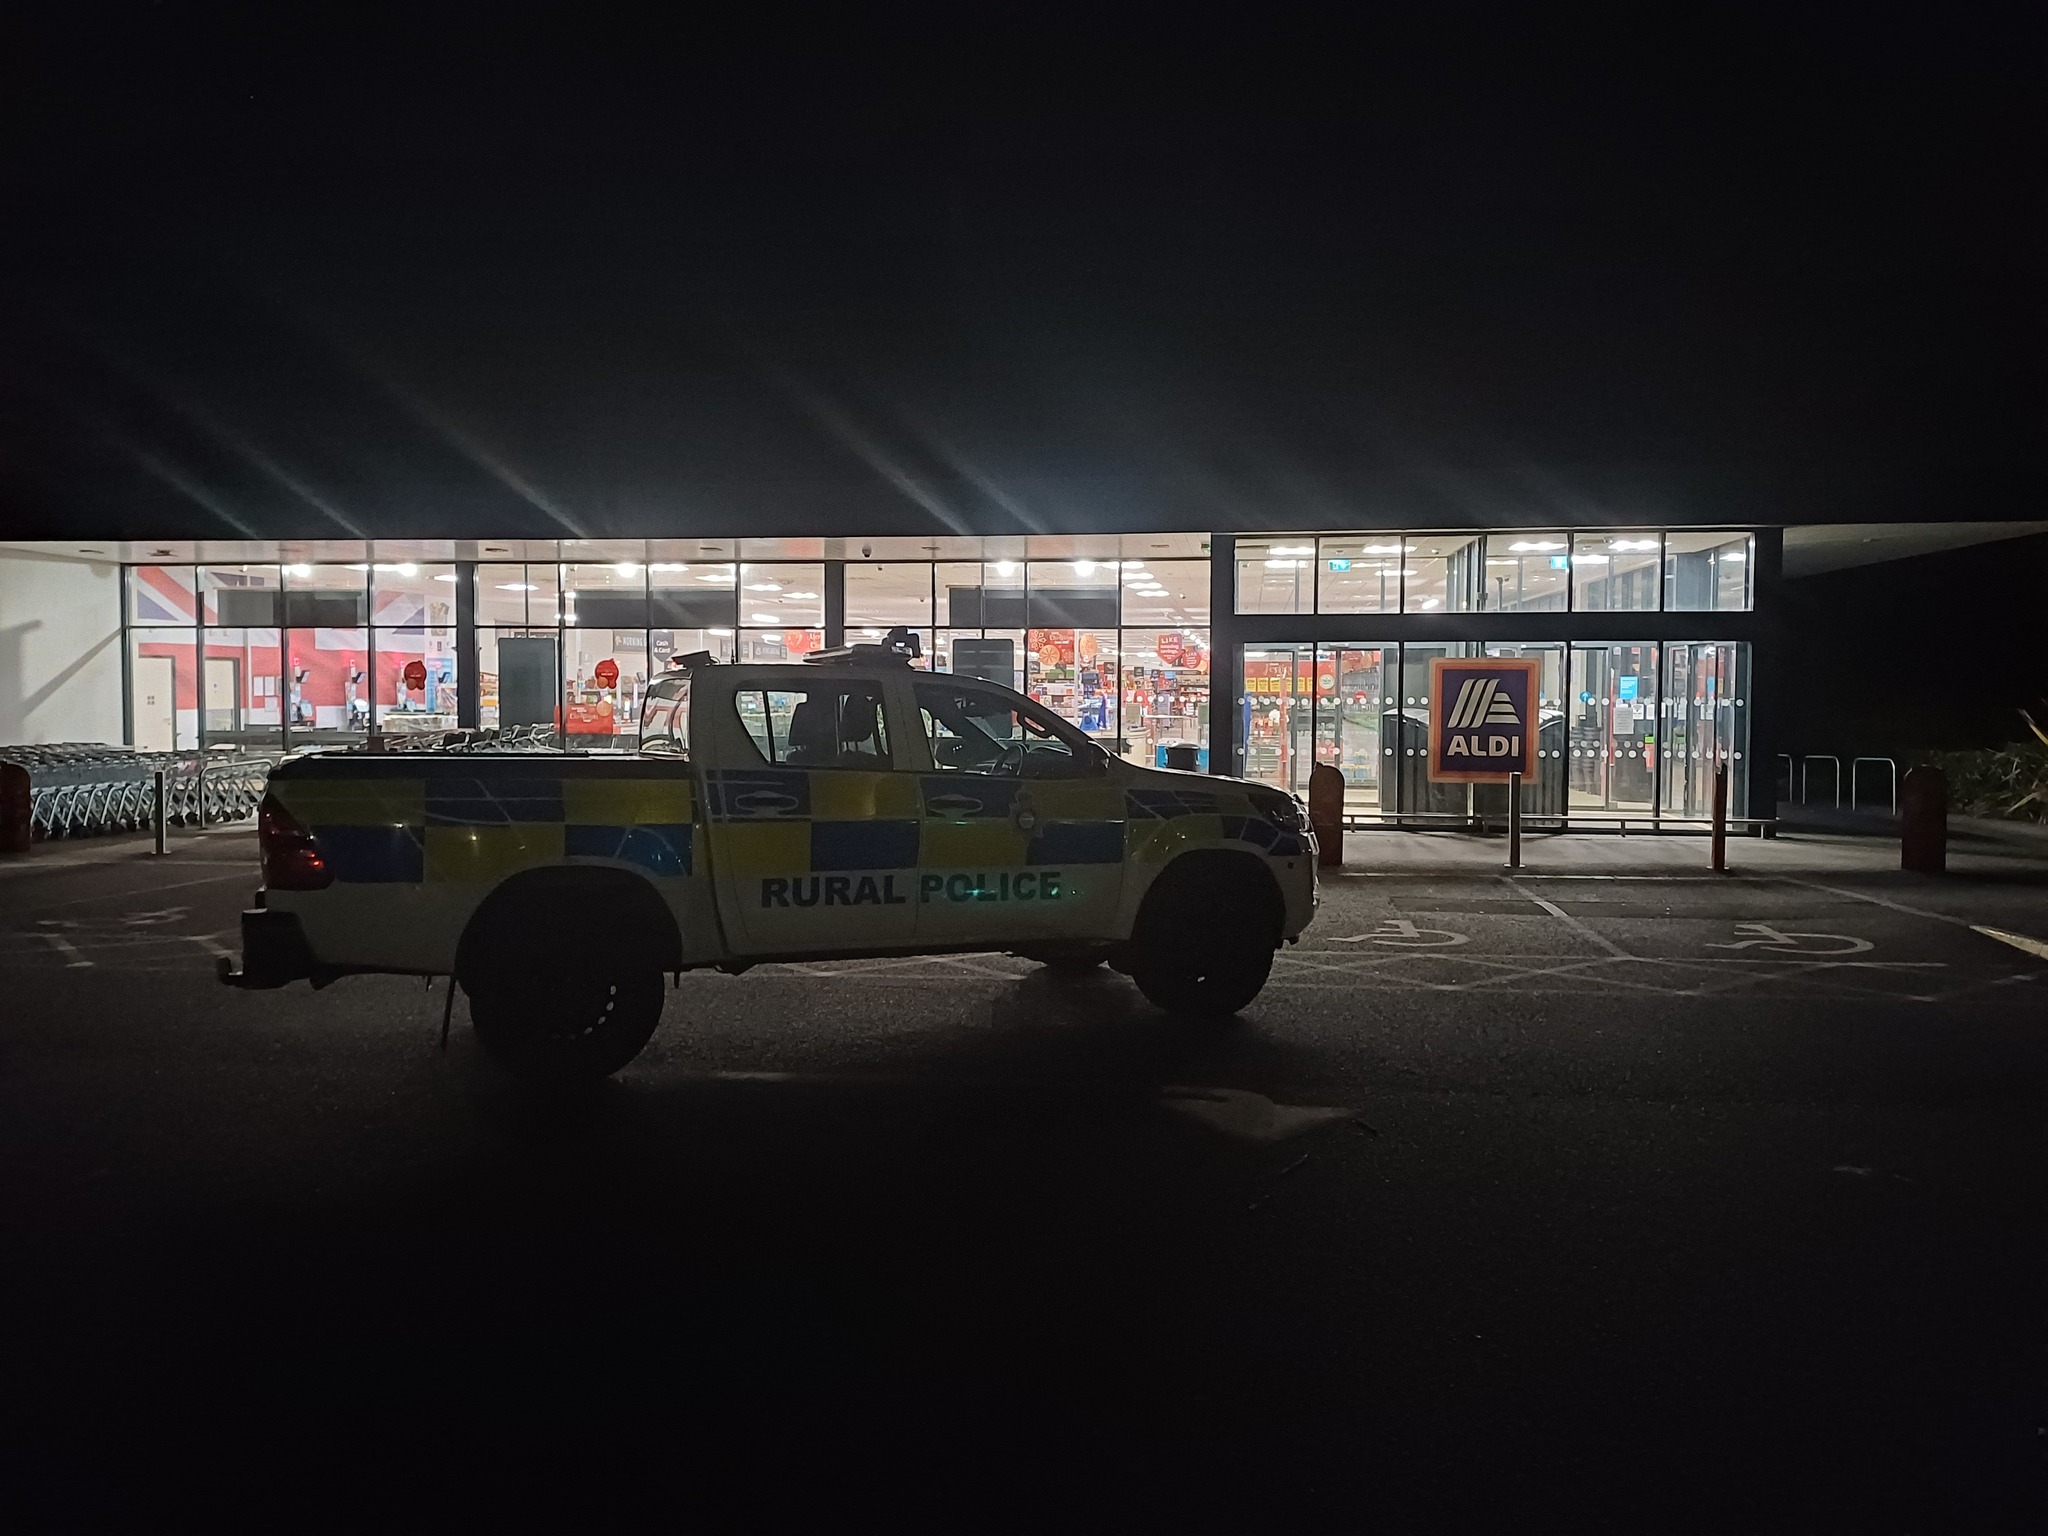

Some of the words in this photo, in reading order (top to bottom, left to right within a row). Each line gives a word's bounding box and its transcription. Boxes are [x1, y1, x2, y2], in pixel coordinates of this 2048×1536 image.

[1161, 636, 1178, 644] LIKE
[1447, 735, 1519, 757] ALDI
[760, 874, 906, 908] RURAL
[920, 871, 1062, 901] POLICE
